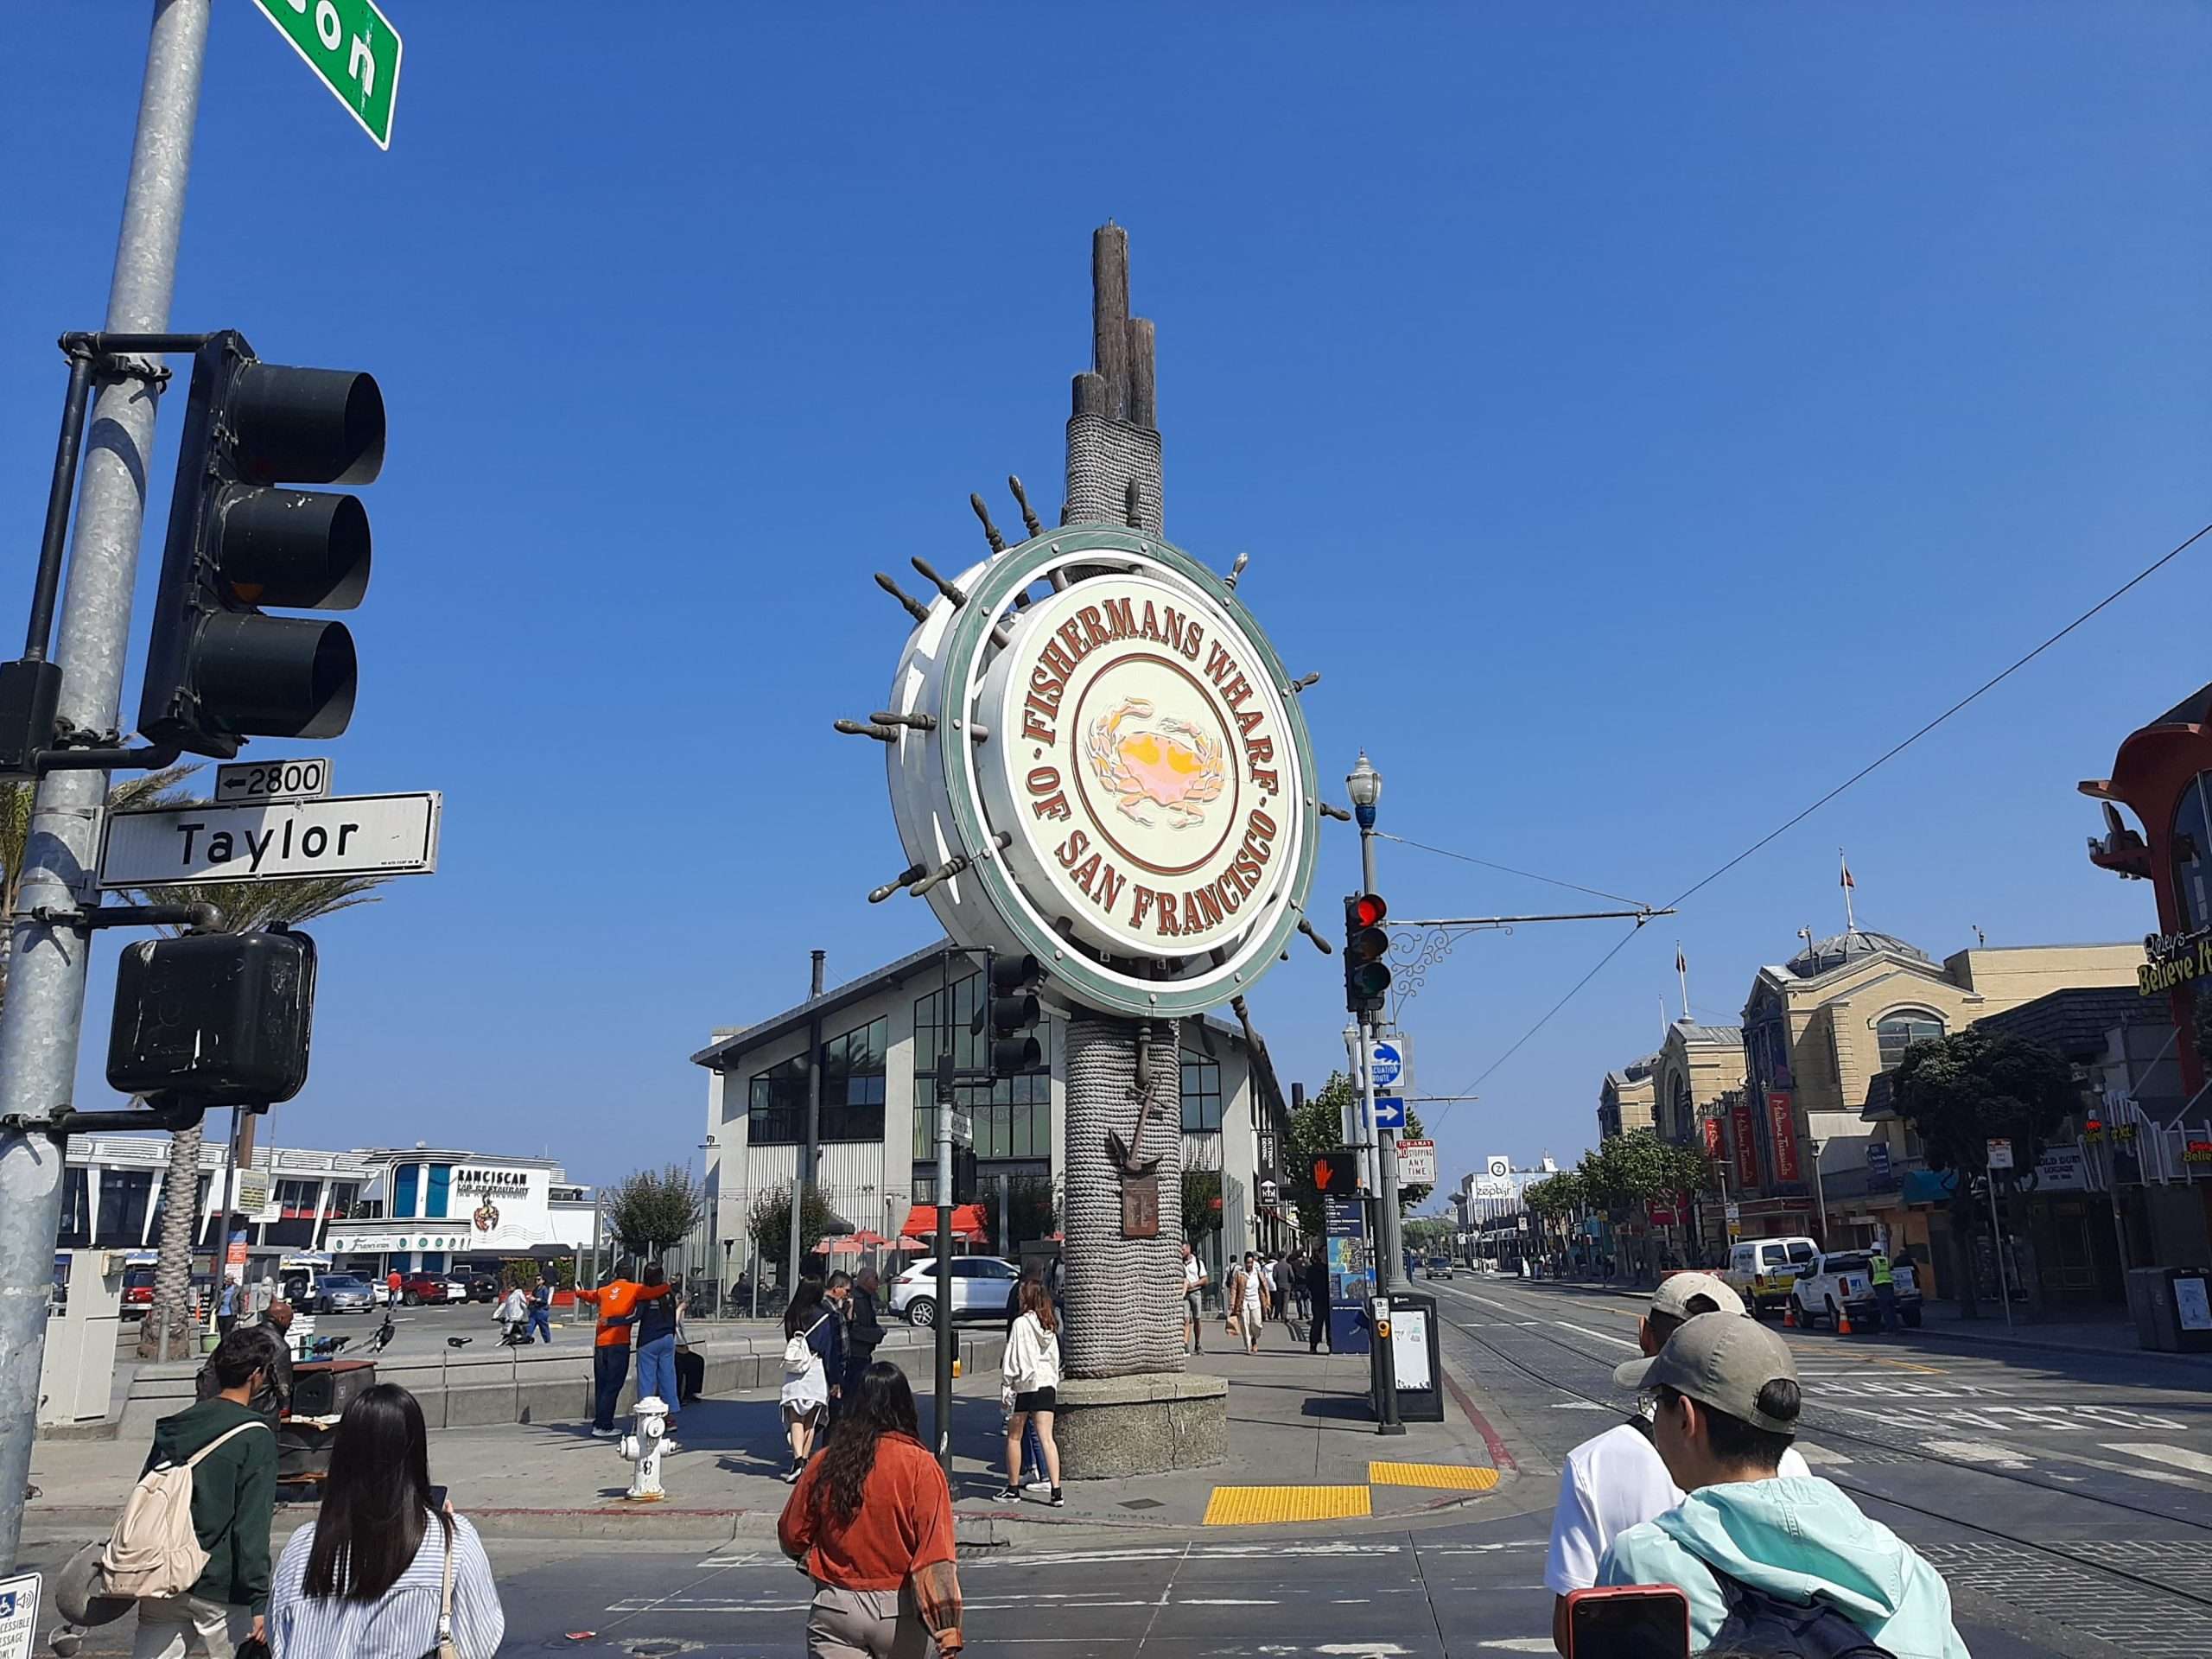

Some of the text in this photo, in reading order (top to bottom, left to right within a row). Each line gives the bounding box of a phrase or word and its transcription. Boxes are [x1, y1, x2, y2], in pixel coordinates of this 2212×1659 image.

[288, 0, 375, 98] on
[1021, 596, 1279, 796] FISHERMANS WHARF
[247, 764, 321, 795] 2800
[177, 818, 359, 873] Taylor
[1026, 766, 1277, 937] OF SAN FRANCISCO
[2138, 956, 2194, 995] Believe
[458, 1170, 527, 1185] RANCISCAN
[0, 1617, 30, 1633] CESSIBLE
[0, 1631, 23, 1647] ESSAGE
